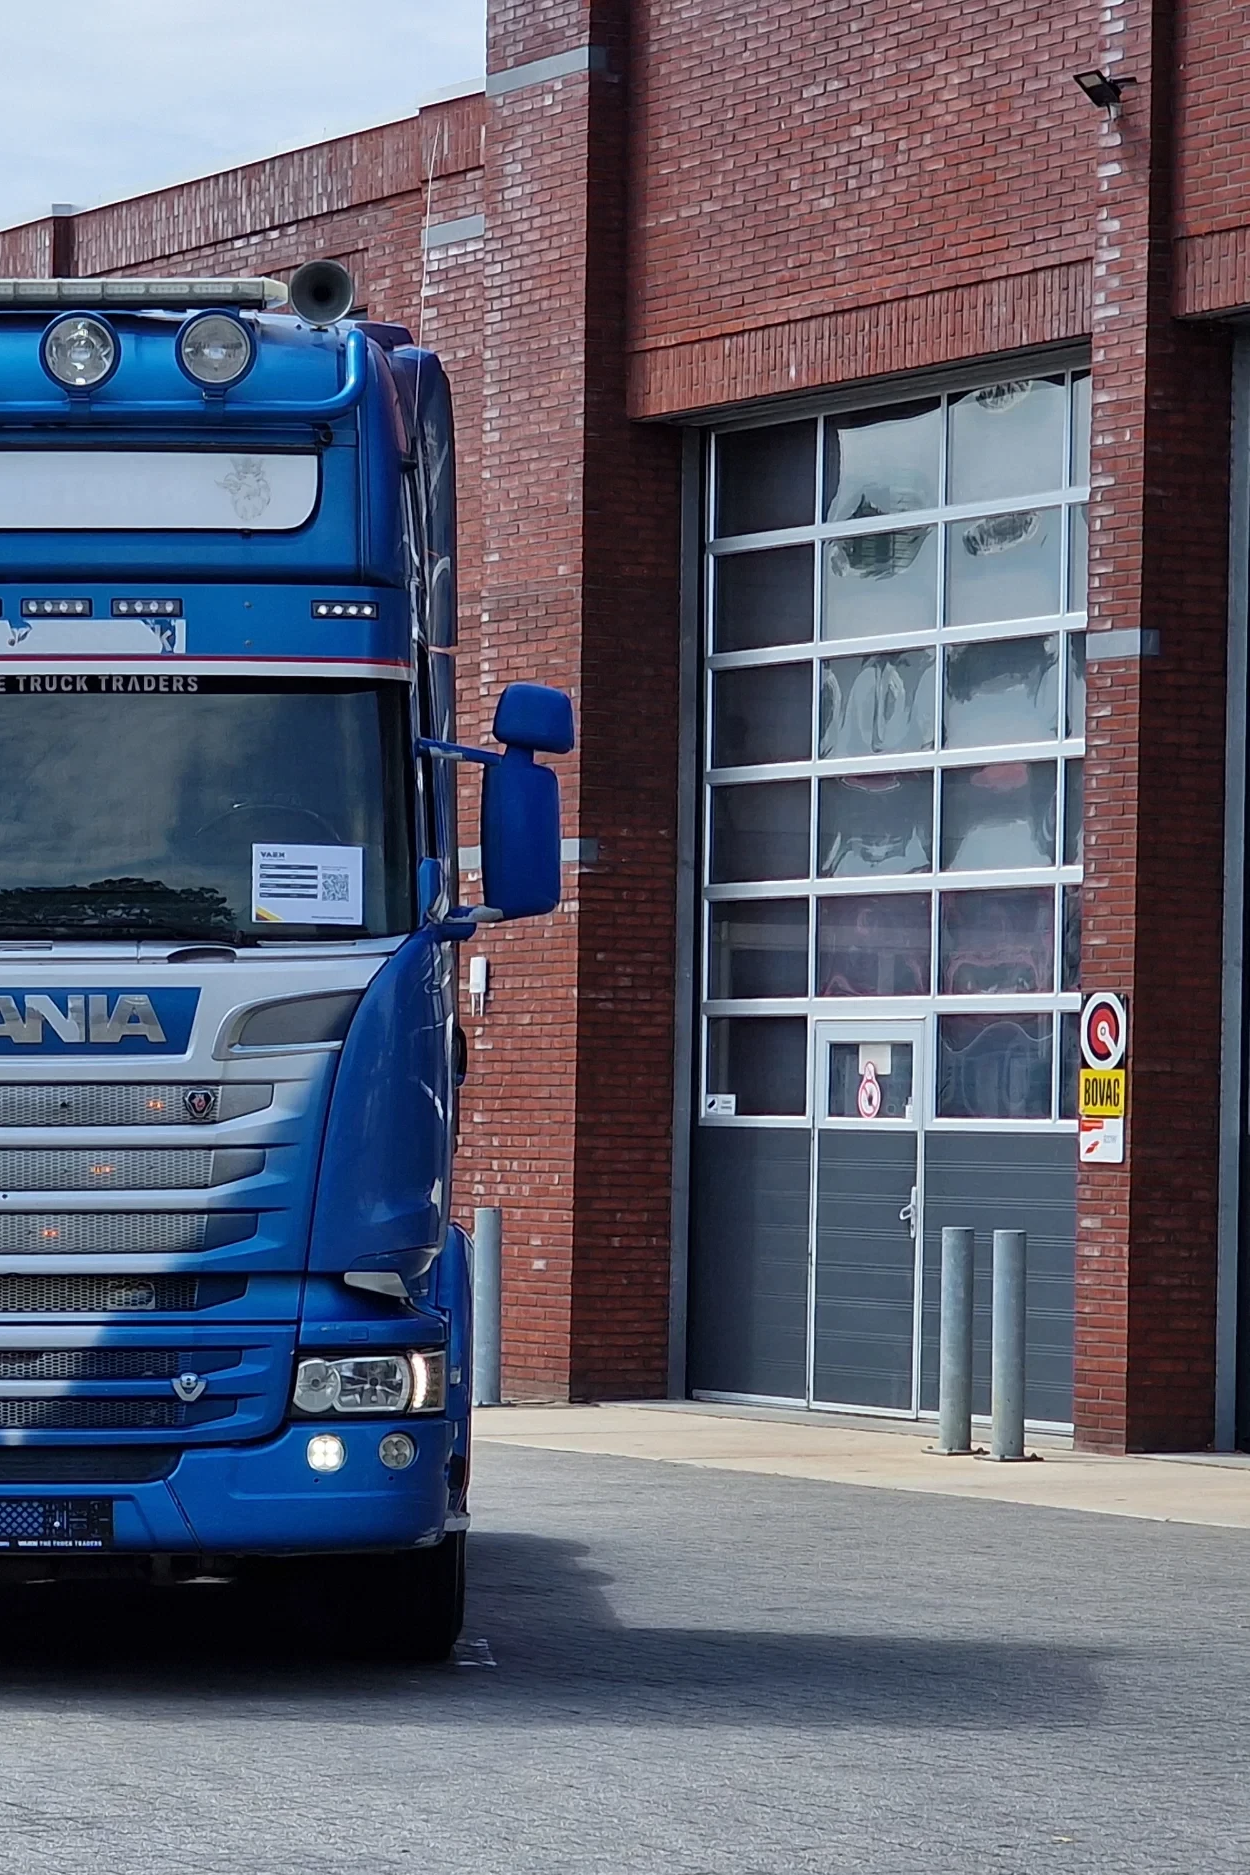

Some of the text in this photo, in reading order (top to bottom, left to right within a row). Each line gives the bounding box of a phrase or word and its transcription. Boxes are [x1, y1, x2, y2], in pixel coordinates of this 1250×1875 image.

[16, 676, 88, 692] TRUCK
[99, 676, 198, 692] TRADERS
[1084, 1077, 1120, 1108] BOVAG
